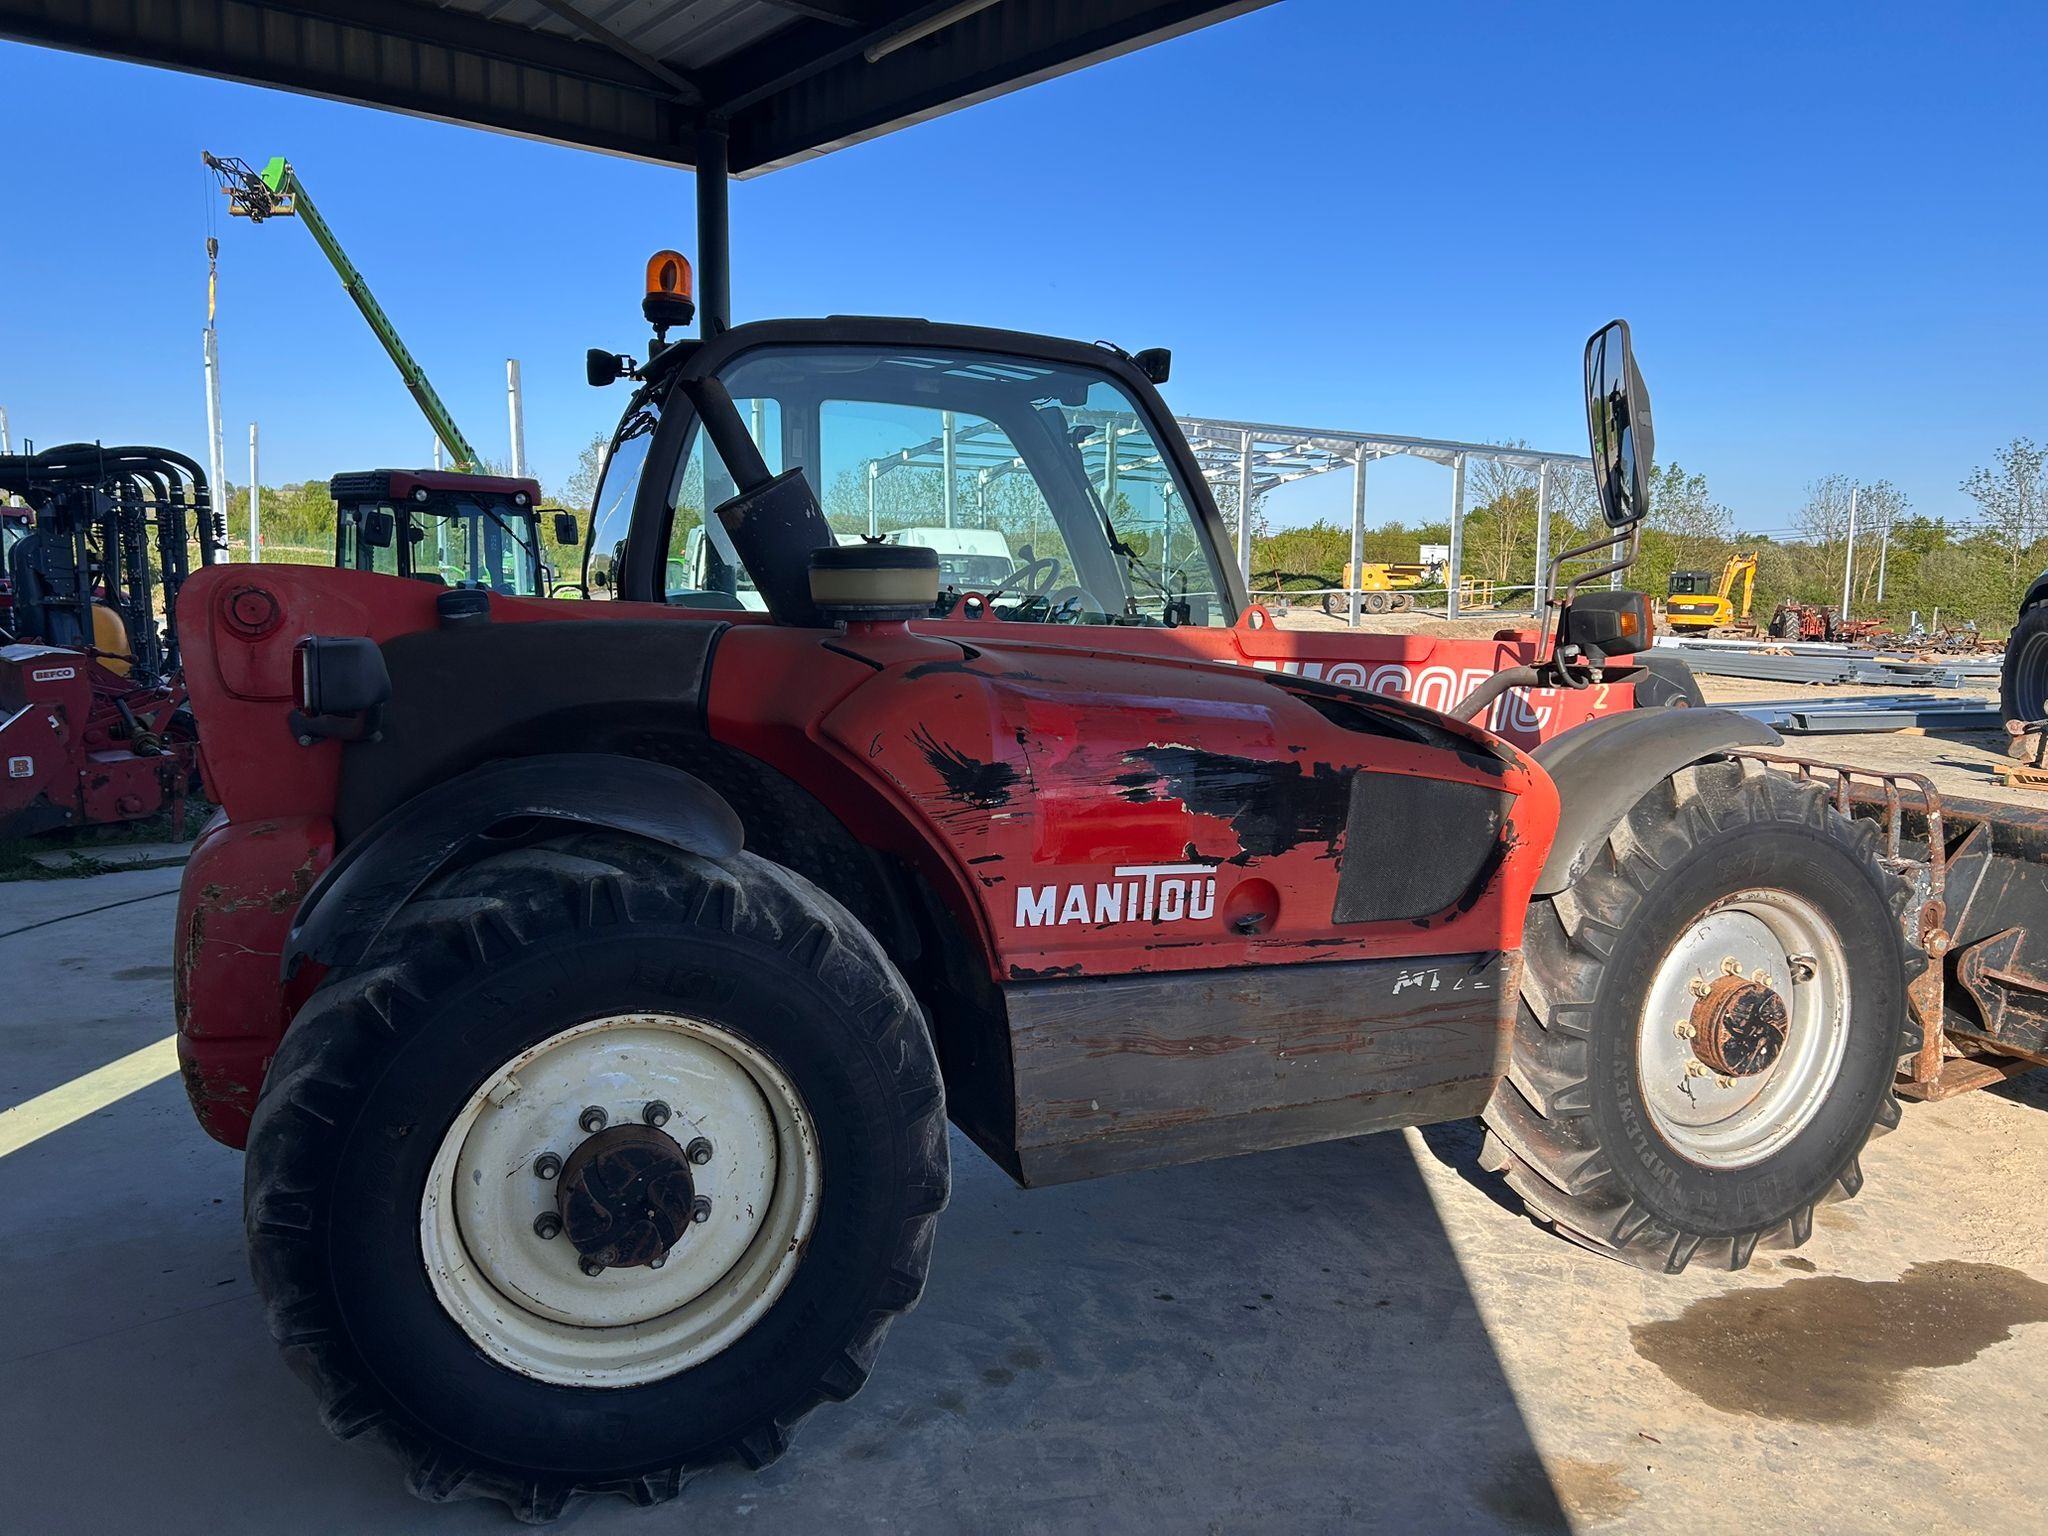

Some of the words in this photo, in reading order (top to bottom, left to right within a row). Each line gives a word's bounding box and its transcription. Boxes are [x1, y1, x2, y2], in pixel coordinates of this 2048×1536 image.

[35, 669, 72, 680] BEFCO
[1593, 683, 1609, 709] 2
[1016, 864, 1217, 928] MANITOU
[1613, 1035, 1682, 1191] IMPLEMENT
